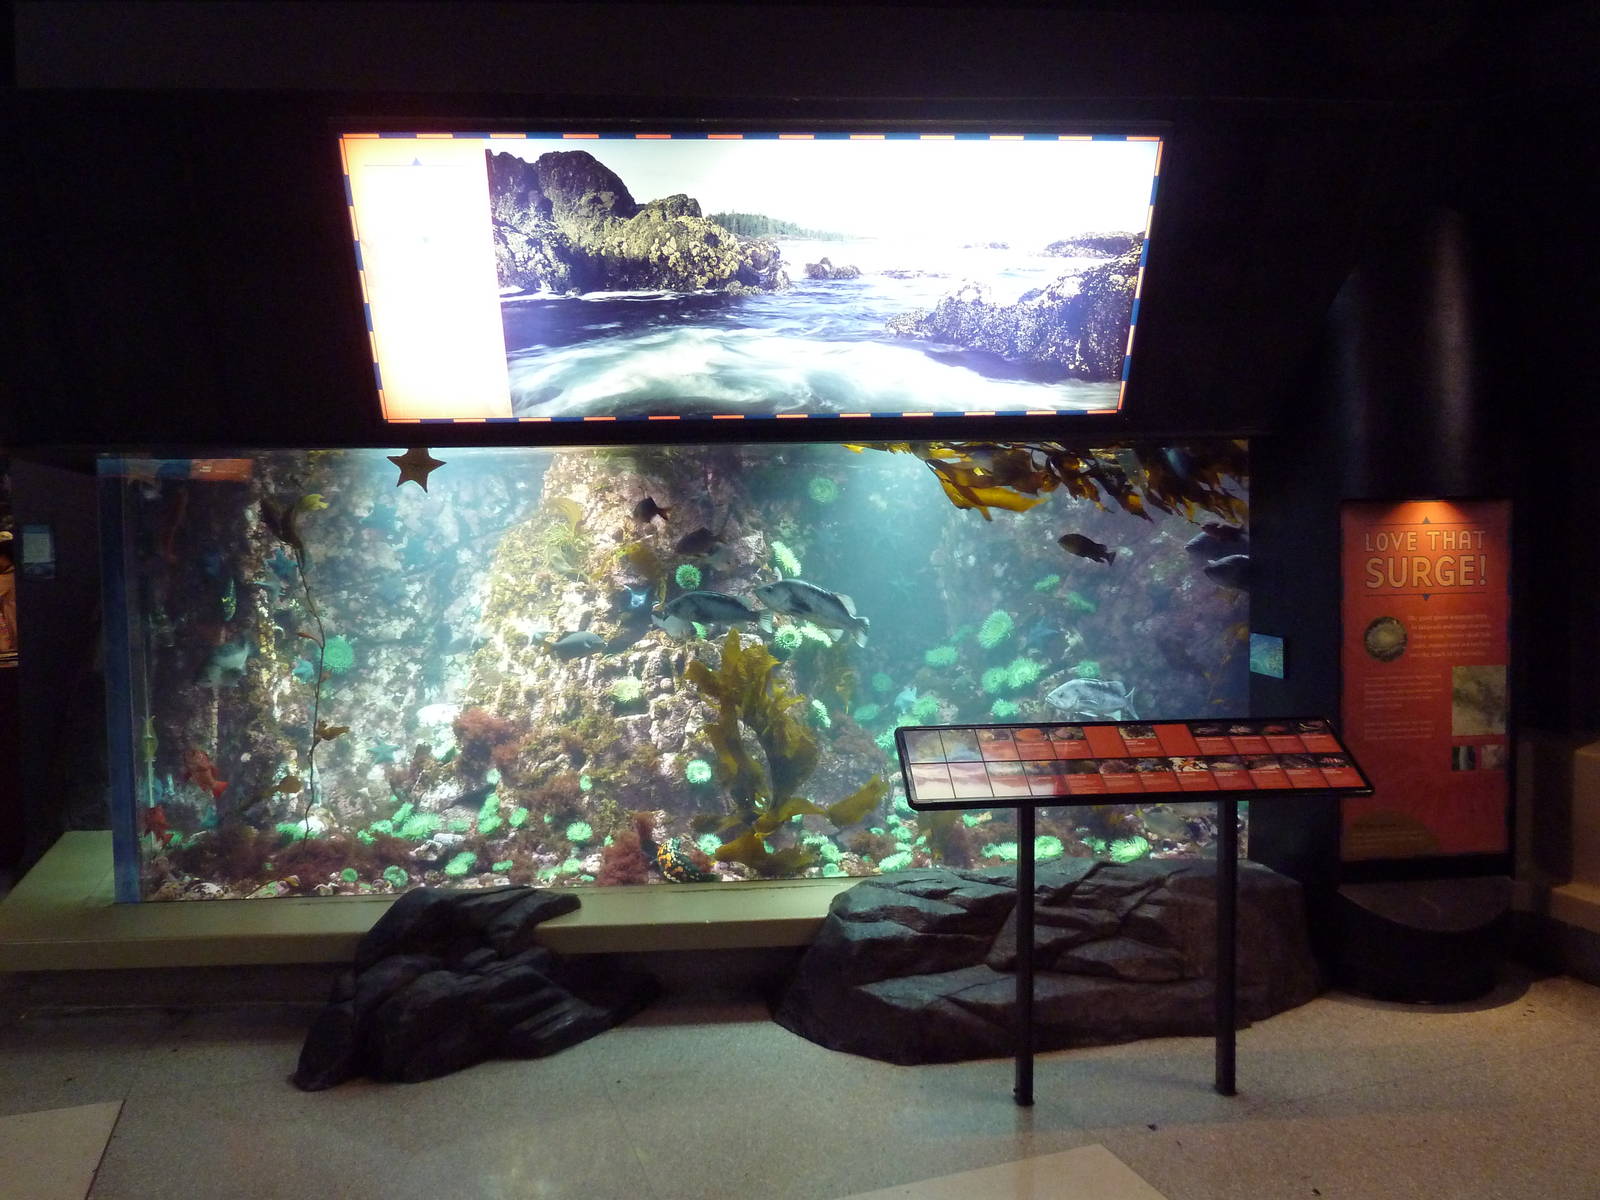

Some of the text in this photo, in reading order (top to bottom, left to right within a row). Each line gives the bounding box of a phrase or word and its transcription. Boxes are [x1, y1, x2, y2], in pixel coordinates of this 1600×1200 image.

[1365, 530, 1486, 552] LOVE THAT
[1365, 555, 1487, 588] SURGE!
